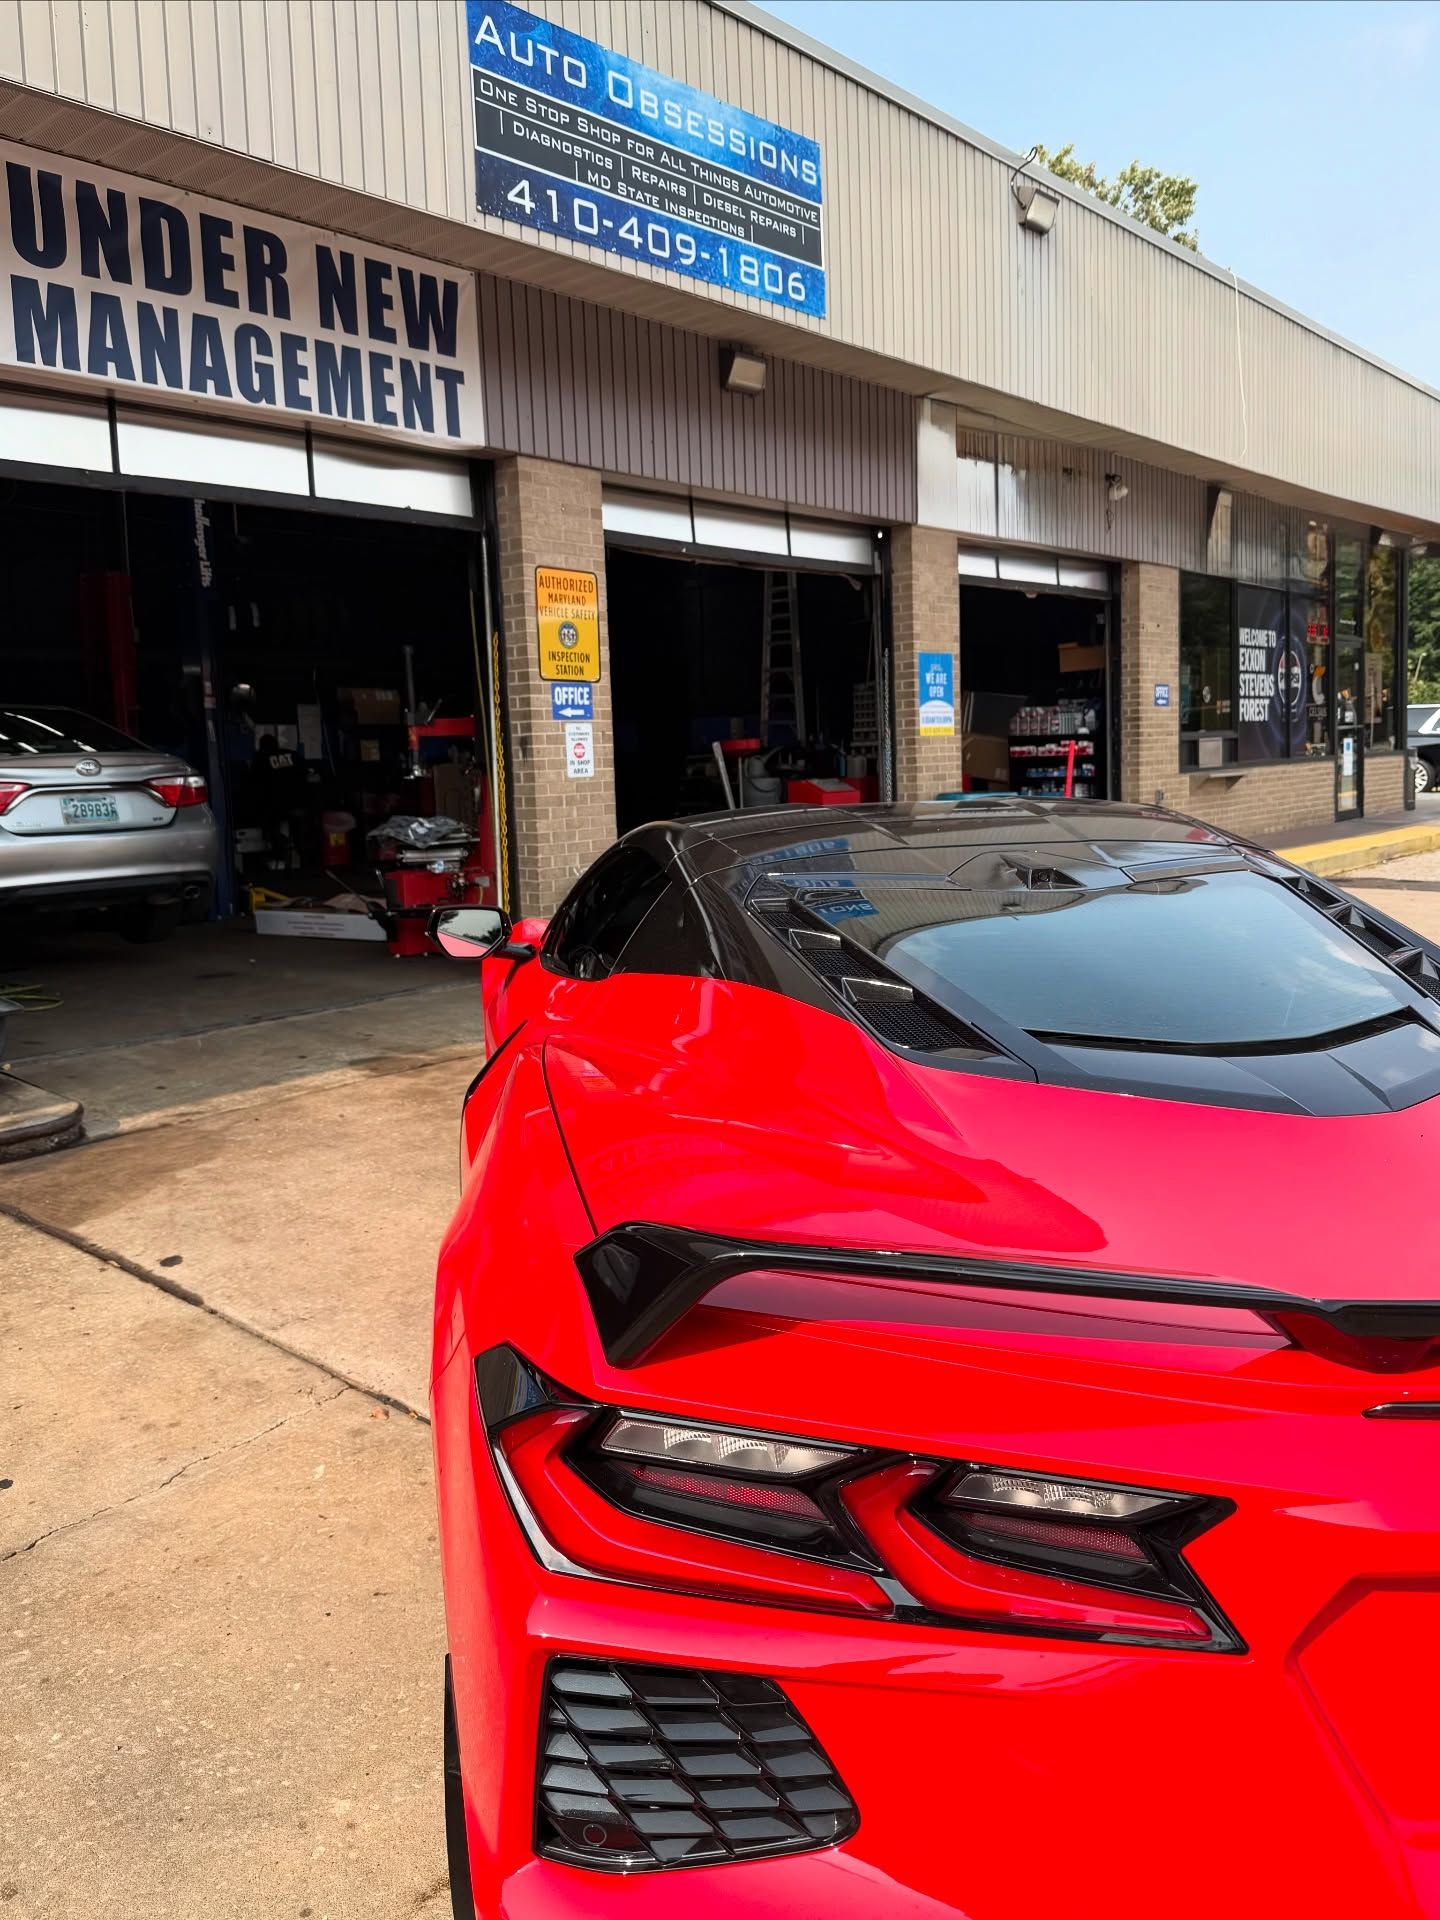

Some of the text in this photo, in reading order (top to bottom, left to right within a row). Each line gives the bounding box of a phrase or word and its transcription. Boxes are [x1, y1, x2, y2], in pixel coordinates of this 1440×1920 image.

[474, 15, 817, 185] AUTO OBSESSIONS
[480, 78, 818, 223] ONE STOP SHOP FOR ALL THINGS AUTOMOTIVE
[513, 120, 797, 238] DIAGNOSTICS REPAIRS DIESEL REPAIRS
[587, 169, 745, 237] MD STATE INSPECTIONS
[507, 179, 806, 301] 410-409-1806
[6, 161, 459, 358] UNDER NEW
[10, 274, 465, 439] MANAGEMENT
[539, 575, 594, 593] AUTHORIZED
[548, 593, 587, 607] MARYLAND
[540, 606, 596, 621] VEHICLE SAFETY
[1239, 627, 1277, 649] WELCOME TO
[548, 651, 591, 663] INSPECTION
[1239, 648, 1266, 672] EXXON
[555, 664, 585, 676] STATION
[925, 672, 935, 685] WE
[554, 686, 590, 706] OFFICE
[929, 686, 945, 698] OPEN
[1239, 673, 1275, 697] STEVENS
[1239, 698, 1270, 722] FOREST
